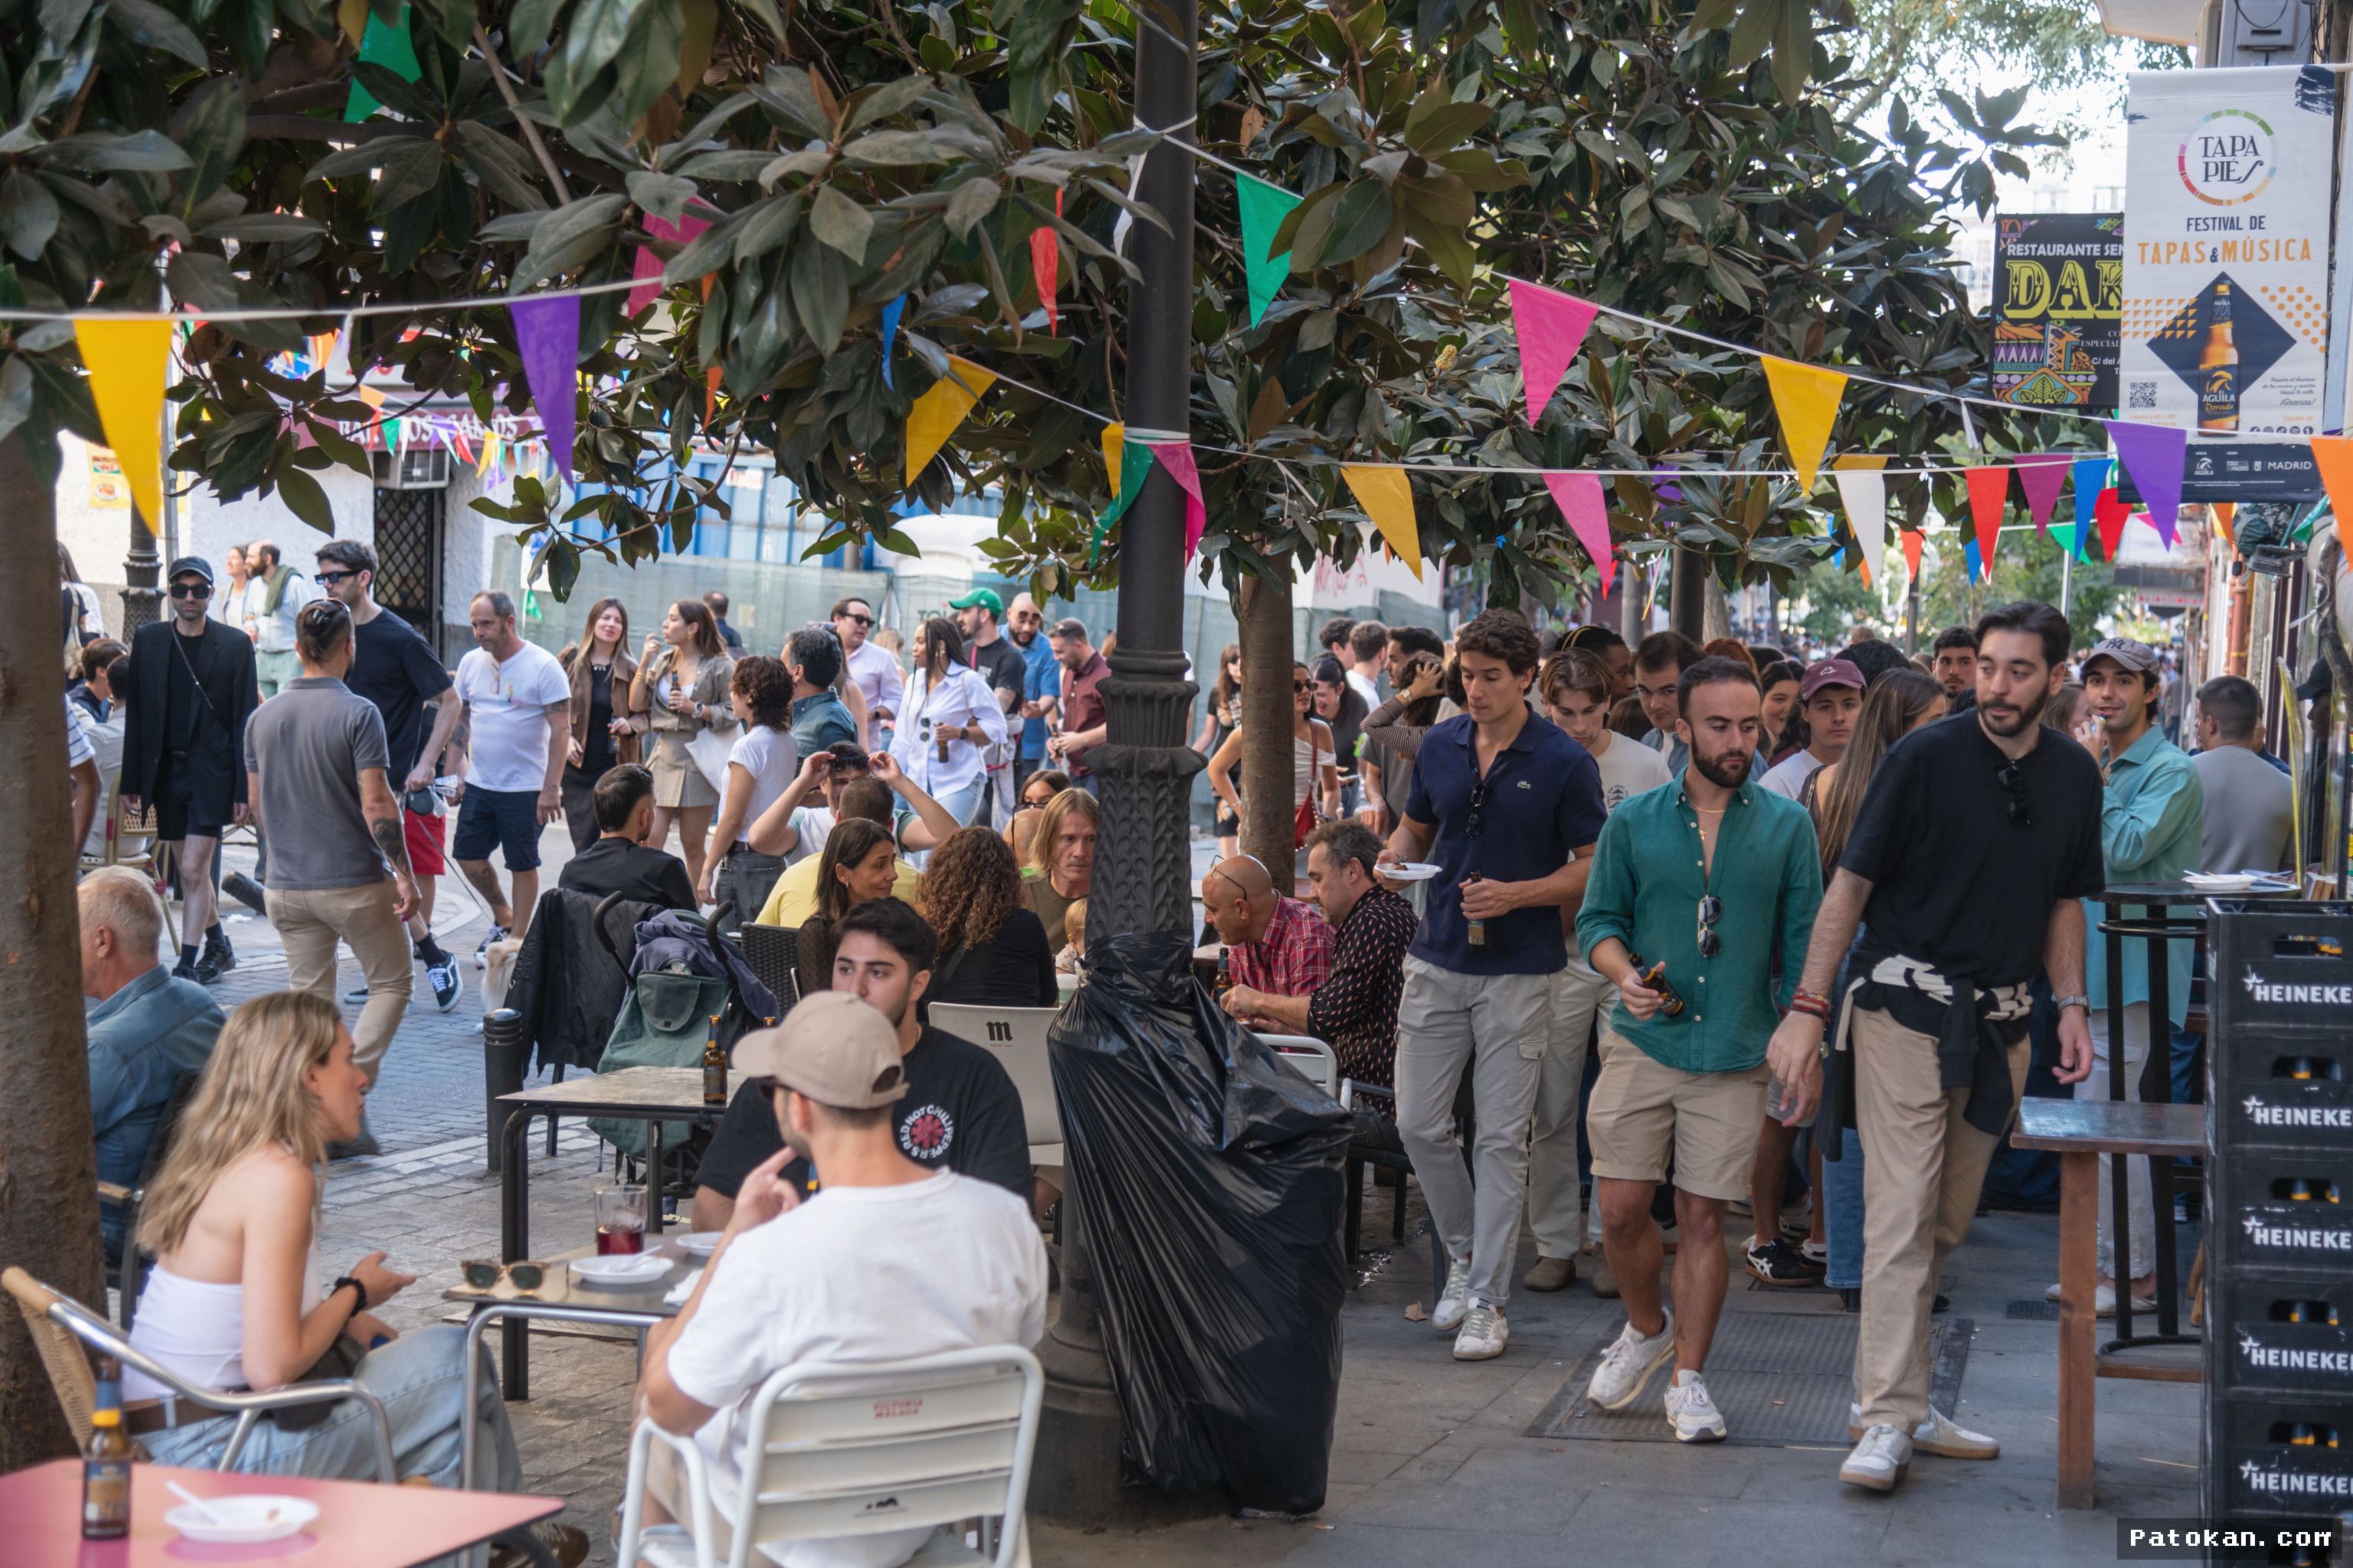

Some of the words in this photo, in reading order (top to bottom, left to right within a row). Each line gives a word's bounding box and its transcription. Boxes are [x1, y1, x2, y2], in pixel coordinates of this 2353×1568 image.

[2198, 136, 2261, 158] TAPA
[2187, 217, 2243, 231] FESTIVAL
[2250, 215, 2266, 230] DE
[2008, 244, 2100, 256] RESTAURANTE
[2138, 241, 2206, 264] TAPAS
[2210, 247, 2218, 263] &
[2222, 237, 2311, 263] MÚSICA
[2268, 461, 2312, 470] MADRID
[905, 1107, 925, 1126] HOT
[927, 1105, 953, 1128] CHILI
[900, 1124, 913, 1151] RED
[911, 1126, 954, 1159] PEPPERS
